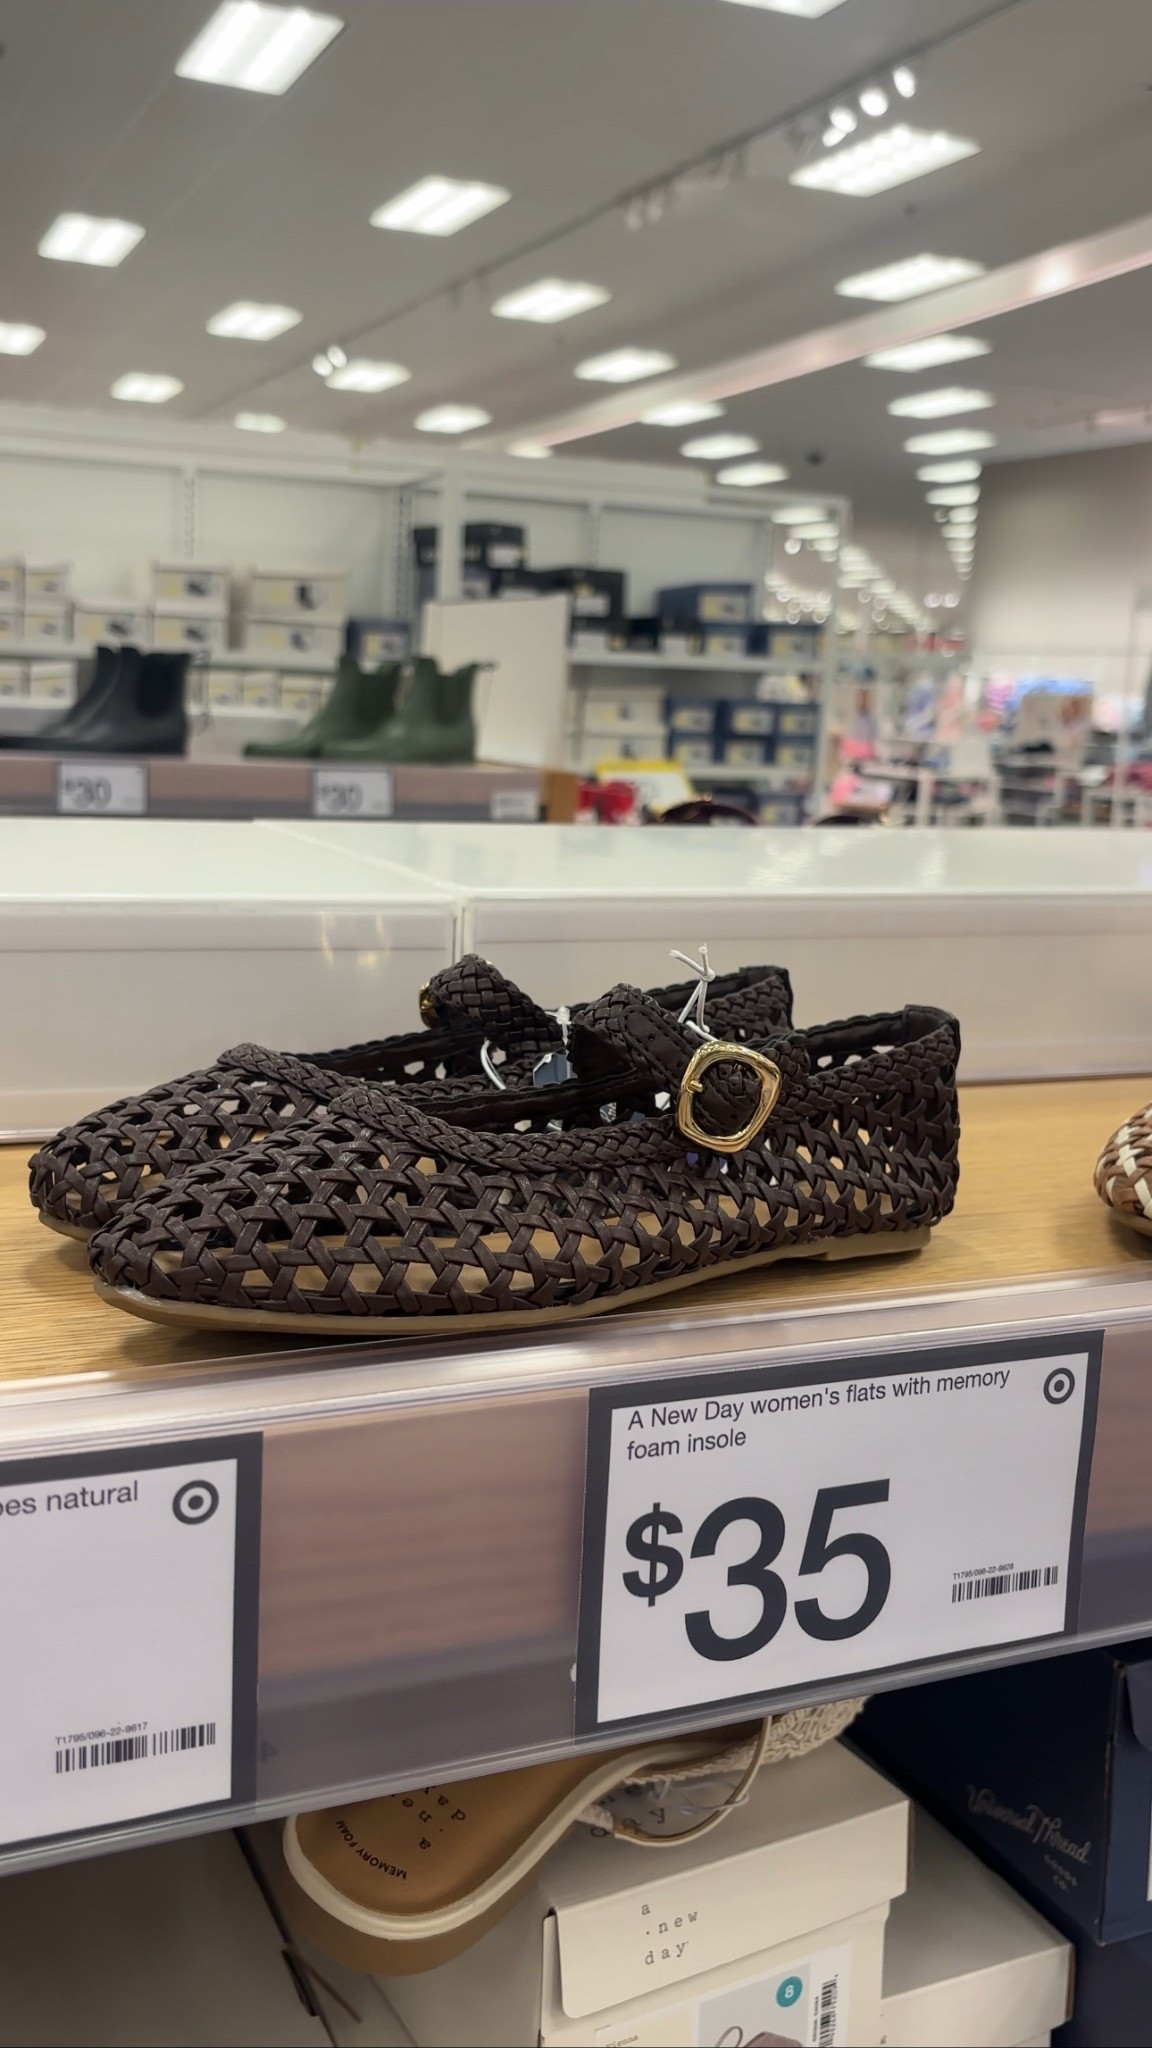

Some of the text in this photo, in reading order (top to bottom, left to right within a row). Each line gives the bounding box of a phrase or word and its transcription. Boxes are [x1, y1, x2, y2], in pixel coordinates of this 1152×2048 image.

[628, 1369, 1011, 1431] A New Day women's flats with memory
[627, 1427, 747, 1461] foam insole
[46, 1479, 138, 1512] natural
[622, 1478, 892, 1662] $35
[335, 1819, 408, 1881] MEMORY FOAM
[641, 1903, 652, 1916] a
[644, 1941, 687, 1966] day
[783, 1984, 795, 1999] 8
